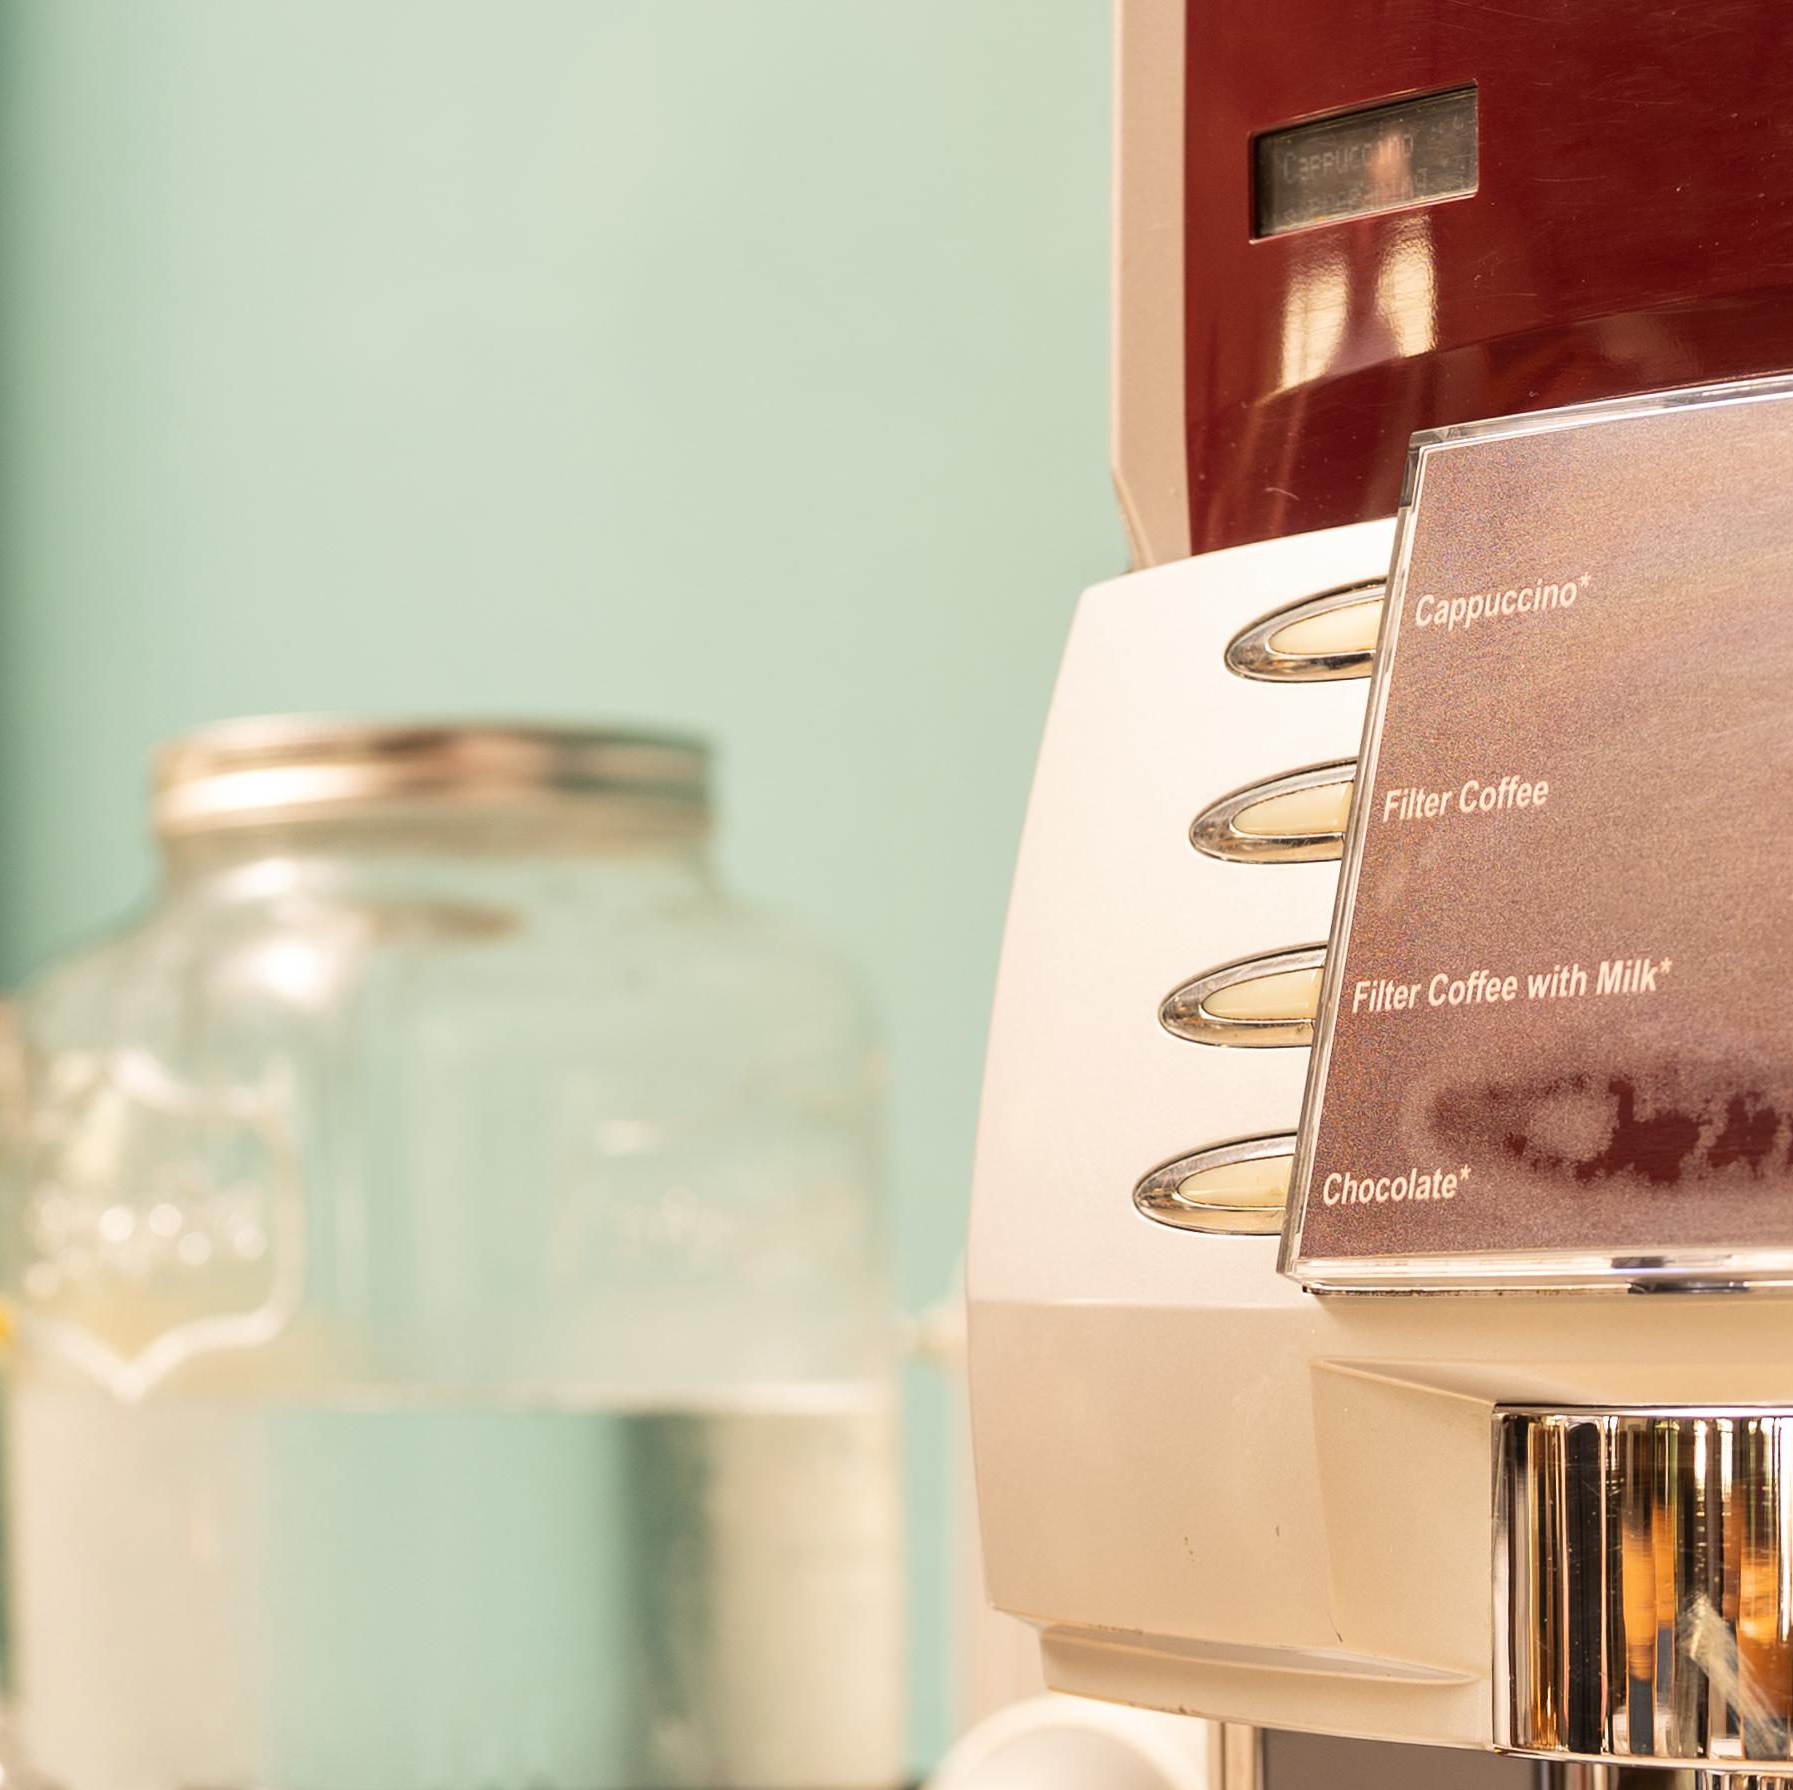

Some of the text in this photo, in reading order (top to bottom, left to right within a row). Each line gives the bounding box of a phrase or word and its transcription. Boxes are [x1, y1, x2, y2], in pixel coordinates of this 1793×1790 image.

[1383, 776, 1549, 822] Filter Coffee
[1353, 979, 1421, 1013] Filter
[1428, 970, 1518, 1008] Coffee
[1527, 964, 1587, 1000] with
